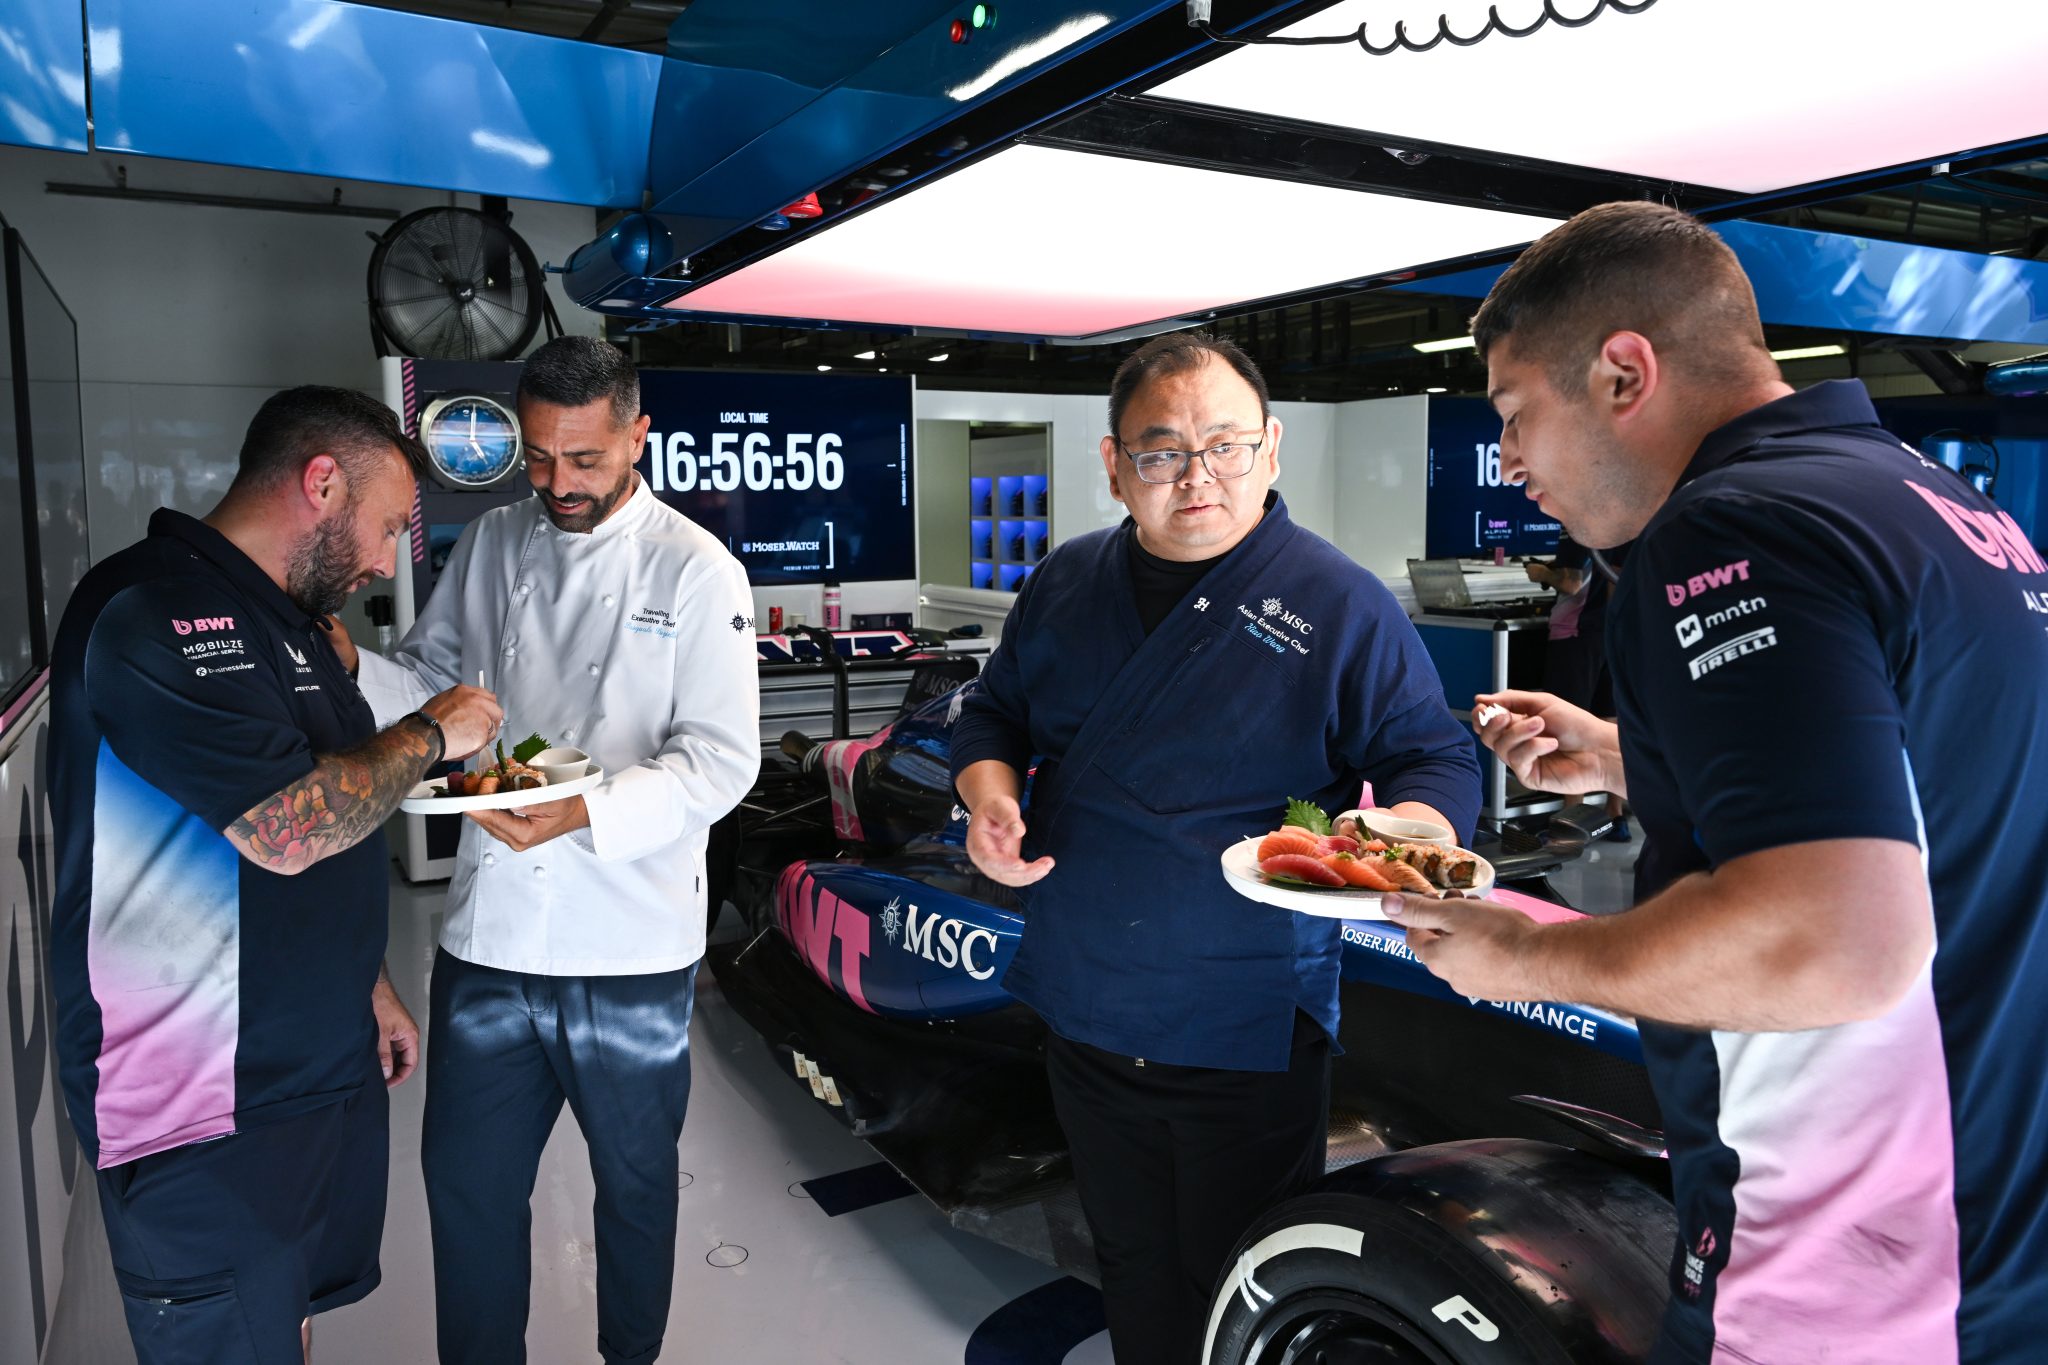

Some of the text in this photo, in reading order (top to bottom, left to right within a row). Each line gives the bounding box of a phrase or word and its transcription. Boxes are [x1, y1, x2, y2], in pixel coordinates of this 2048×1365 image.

[720, 412, 769, 424] LOCAL TIME
[647, 431, 844, 492] 16:56:56
[752, 541, 819, 552] MOSER.WATCH
[1687, 559, 1750, 597] BWT
[193, 617, 235, 632] BWT
[631, 614, 676, 628] Executive Chef
[1237, 604, 1310, 655] Asian Executive Chef
[1280, 610, 1313, 635] MSC
[1705, 597, 1767, 629] mntn
[1688, 626, 1778, 681] PIRELLI
[903, 904, 998, 980] MSC
[1340, 925, 1425, 964] OSER.WAT
